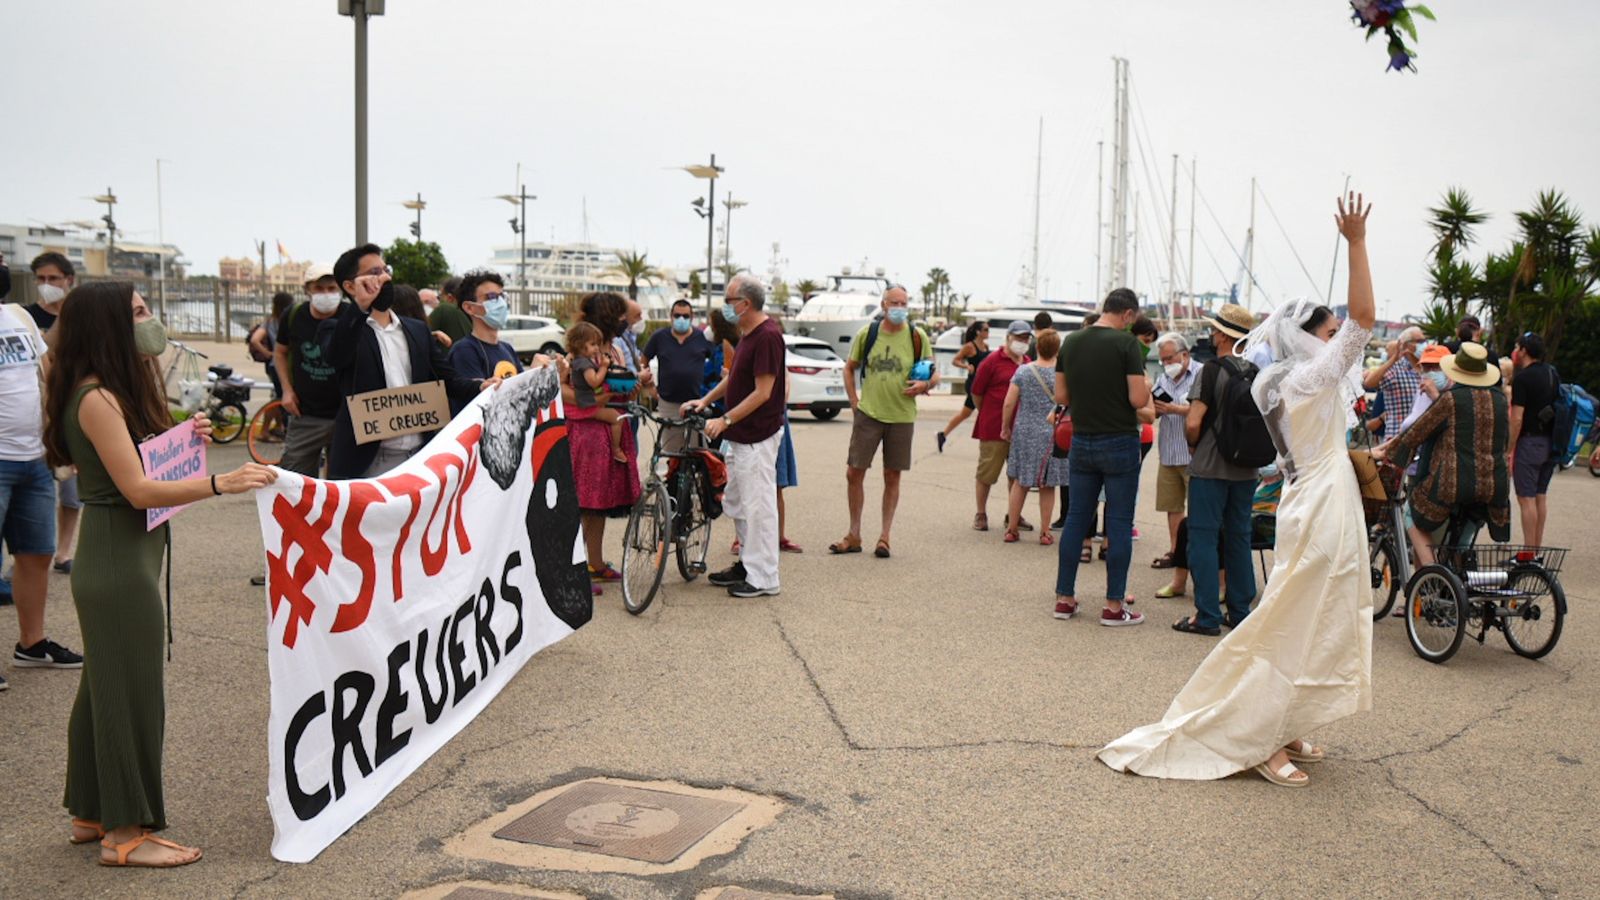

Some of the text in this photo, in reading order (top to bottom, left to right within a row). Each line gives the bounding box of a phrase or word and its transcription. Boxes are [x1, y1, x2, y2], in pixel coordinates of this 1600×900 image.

[362, 392, 426, 413] TERMINAL
[363, 410, 439, 435] DE CREUERS
[148, 438, 185, 472] Ministeri
[284, 550, 524, 821] CREUERS
